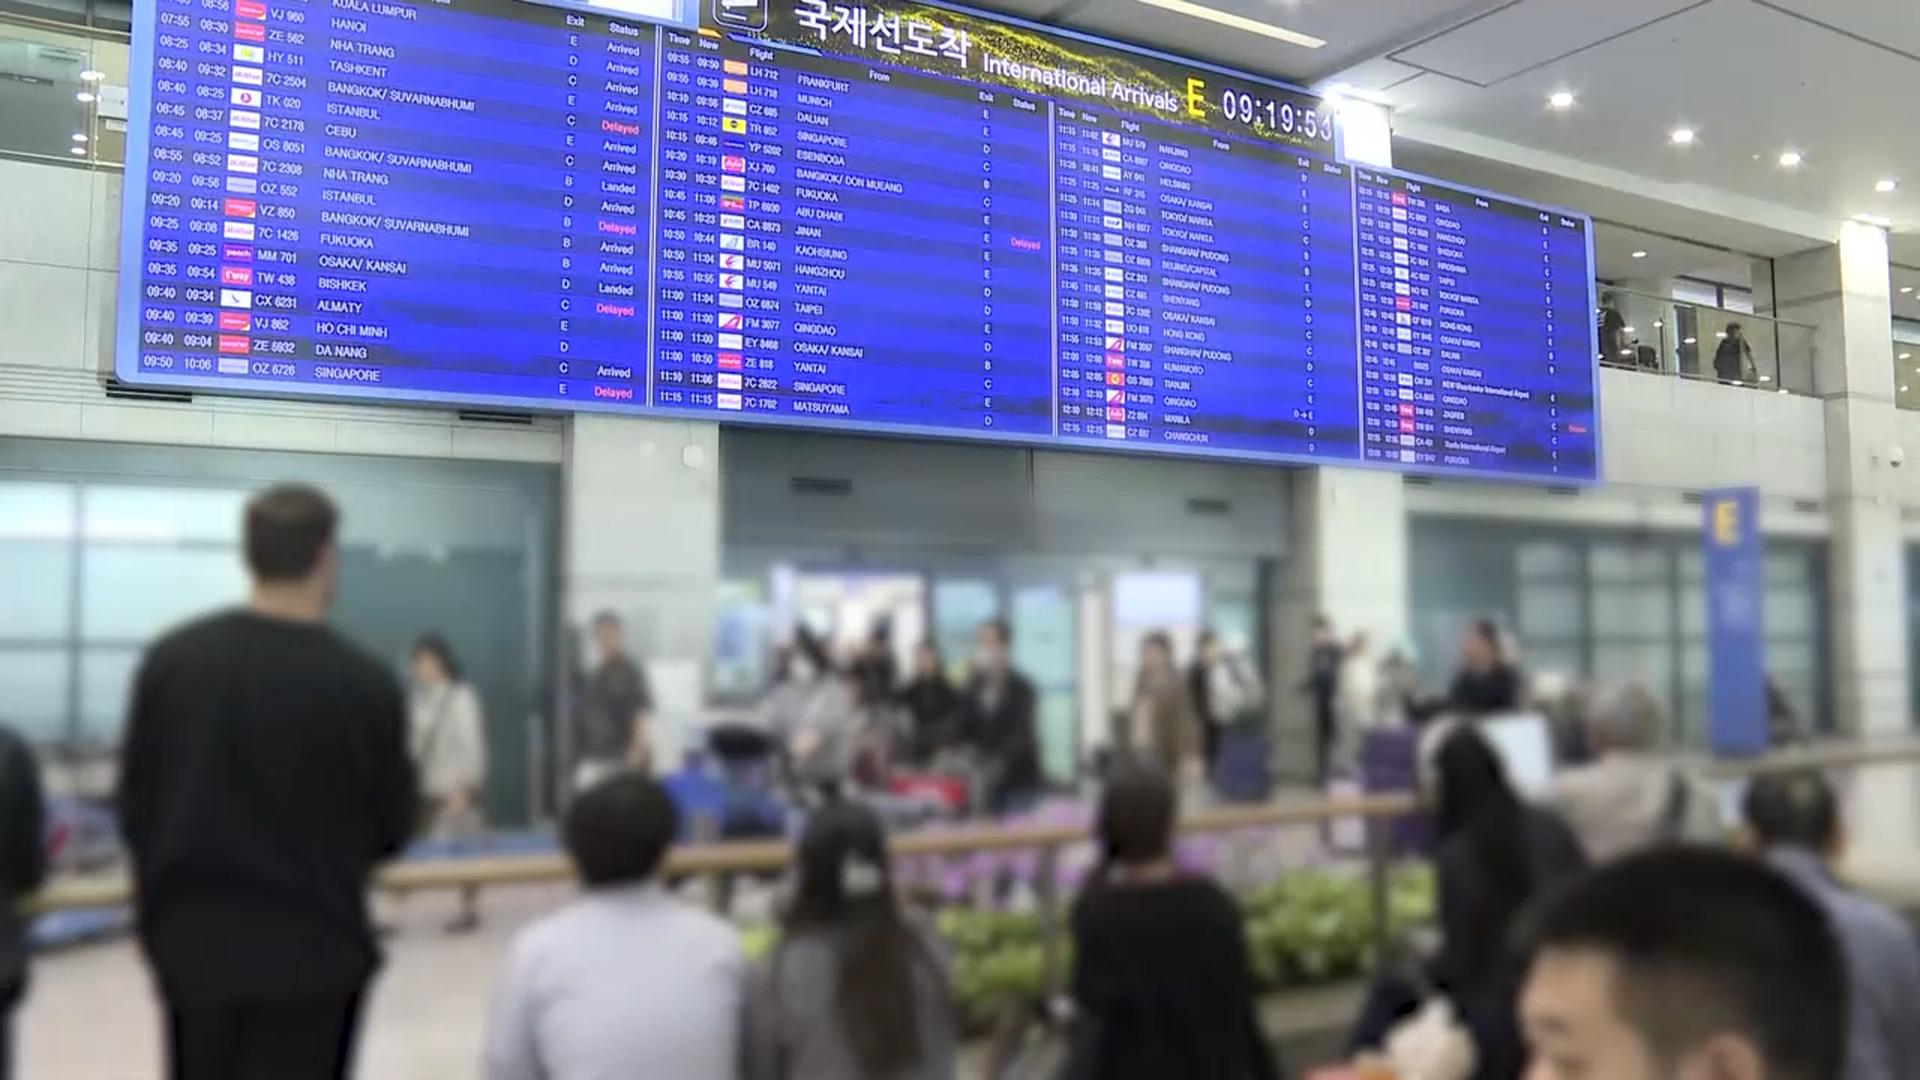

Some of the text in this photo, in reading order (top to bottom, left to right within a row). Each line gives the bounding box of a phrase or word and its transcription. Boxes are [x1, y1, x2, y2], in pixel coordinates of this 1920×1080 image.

[271, 8, 284, 20] VJ
[331, 18, 366, 32] HANOI
[606, 61, 639, 76] Arrived
[332, 0, 369, 12] KUALA
[371, 3, 416, 20] LUMPUR
[607, 42, 640, 56] Arrived
[566, 15, 638, 36] Exit Status
[794, 0, 971, 69] 국제선도착
[269, 29, 284, 41] ZE
[330, 38, 354, 52] NHA
[356, 42, 395, 58] TRANG
[605, 81, 638, 95] Arrived
[668, 32, 690, 46] Time
[749, 47, 774, 61] Flight
[869, 69, 890, 82] From
[979, 90, 994, 103] Exit
[1013, 96, 1036, 111] Status
[268, 51, 284, 63] HY
[287, 54, 303, 66] 511
[330, 60, 387, 78] TASHKENT
[605, 101, 638, 115] Arrived
[797, 75, 849, 93] FRANKFURT
[797, 94, 832, 108] MUNICH
[983, 53, 1206, 119] International Arrivals E
[266, 72, 282, 85] 7C
[283, 75, 306, 88] 2504
[328, 82, 389, 100] BANGKOK/
[391, 89, 475, 110] SUVARNABHUMI
[602, 120, 639, 134] Delayed
[797, 112, 829, 126] DALIAN
[266, 95, 281, 106] TK
[327, 103, 380, 120] ISTANBUL
[603, 140, 637, 154] Arrived
[796, 131, 848, 148] SINGAPORE
[264, 116, 279, 128] 7C
[281, 119, 304, 132] 2178
[325, 124, 357, 138] CEBU
[602, 160, 636, 174] Arrived
[263, 138, 280, 151] OS
[325, 146, 384, 163] BANGKOK/
[387, 153, 472, 174] SUVARNABHUMI
[601, 180, 636, 194] Landed
[262, 160, 277, 172] 7C
[323, 168, 347, 180] NHA
[350, 170, 389, 185] TRANG
[601, 200, 635, 214] Arrived
[260, 182, 277, 194] OZ
[323, 190, 376, 205] ISTANBUL
[598, 221, 635, 234] Delayed
[260, 205, 275, 217] VZ
[321, 212, 382, 228] BANGKOK/
[384, 217, 469, 237] SUVARNABHUMI
[600, 241, 634, 255] Arrived
[795, 206, 1041, 250] ABU DHABI Delayed
[795, 226, 822, 238] JINAN
[258, 227, 273, 239] 7C
[320, 234, 374, 249] FUKUOKA
[600, 262, 633, 275] Arrived
[795, 245, 847, 260] KAOHSIUNG
[257, 249, 277, 261] MM
[280, 251, 296, 264] 701
[319, 255, 364, 271] OSAKA/
[366, 259, 406, 274] KANSAI
[599, 282, 634, 296] Landed
[795, 264, 845, 279] HANGZHOU
[795, 283, 827, 296] YANTAI
[255, 294, 273, 306] CX
[317, 299, 362, 314] ALMATY
[256, 272, 276, 284] TW
[318, 278, 367, 292] BISHKEK
[596, 303, 633, 317] Delayed
[794, 302, 823, 315] TAIPEI
[255, 317, 269, 329] VJ
[316, 322, 336, 334] HO
[335, 323, 356, 336] CHI
[359, 325, 388, 338] MINH
[794, 322, 836, 336] QINGDAO
[252, 339, 270, 352] ZE
[315, 344, 333, 356] DA
[334, 345, 367, 359] NANG
[597, 365, 631, 378] Arrived
[793, 341, 863, 358] OSAKA/ KANSAI
[794, 362, 826, 374] YANTAI
[252, 362, 270, 374] OZ
[314, 366, 381, 382] SINGAPORE
[595, 386, 632, 400] Delayed
[793, 381, 845, 395] SINGAPORE
[793, 400, 850, 415] MATSUYAMA
